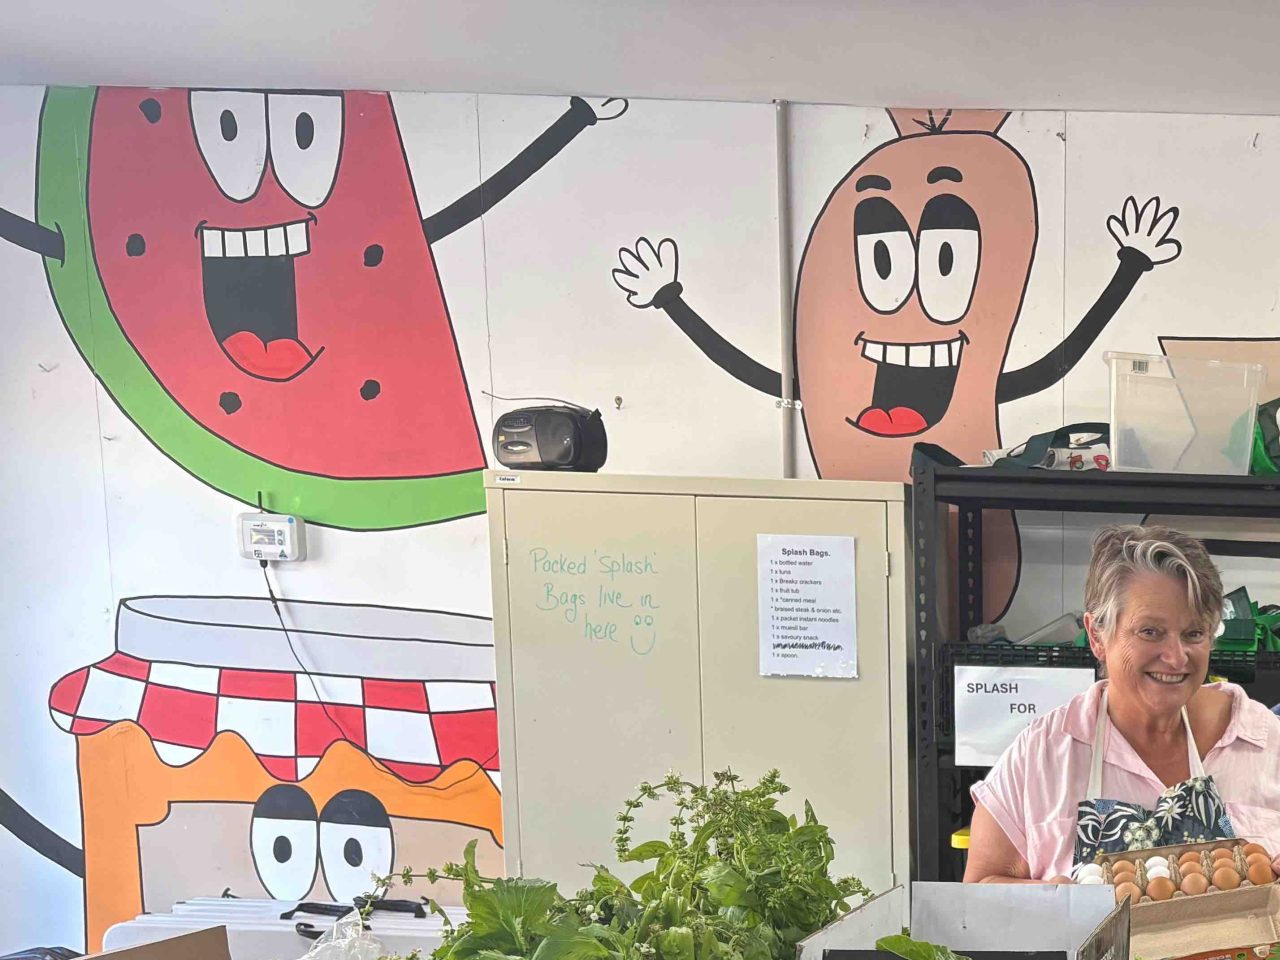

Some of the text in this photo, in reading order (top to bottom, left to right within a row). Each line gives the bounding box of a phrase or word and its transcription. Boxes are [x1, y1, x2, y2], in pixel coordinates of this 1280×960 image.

[529, 548, 587, 576] Packed
[781, 548, 831, 558] Splash Bags.
[536, 582, 661, 624] Bags live in
[585, 613, 620, 643] here
[966, 683, 1019, 694] SPLASH
[1009, 703, 1036, 714] FOR
